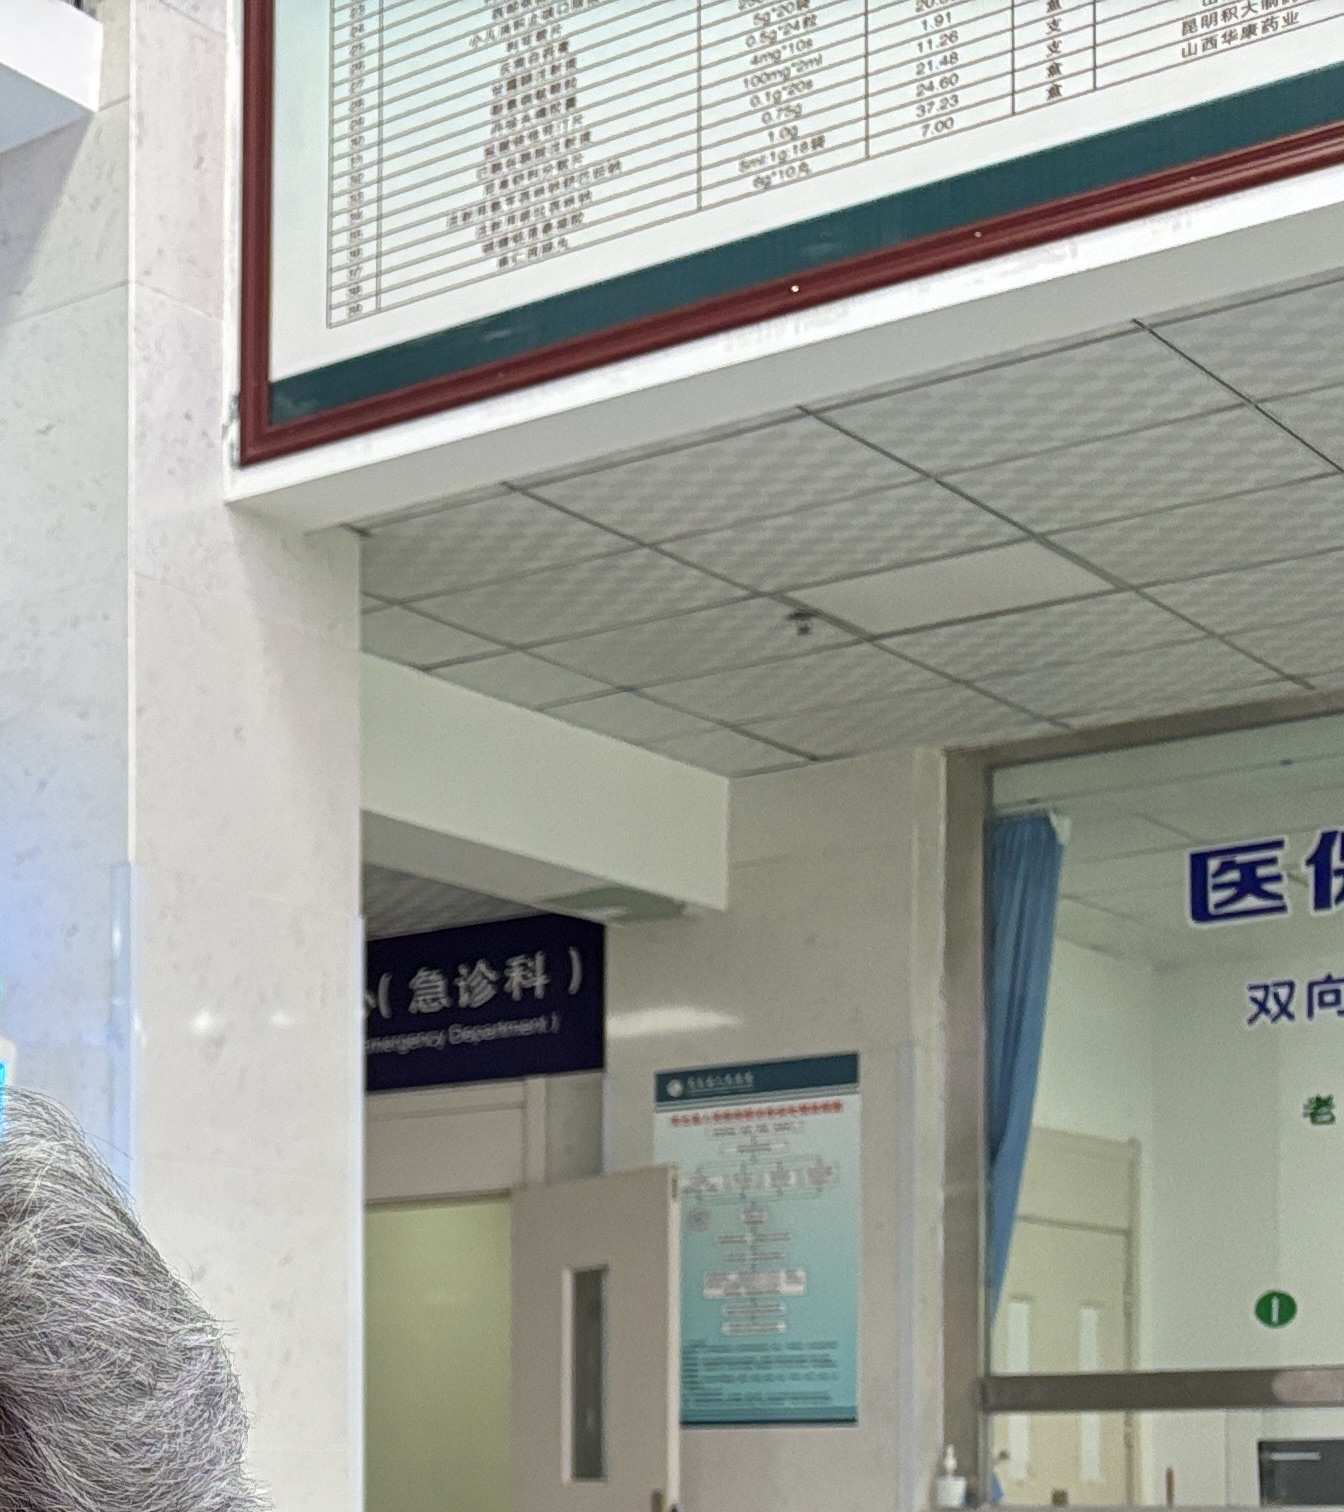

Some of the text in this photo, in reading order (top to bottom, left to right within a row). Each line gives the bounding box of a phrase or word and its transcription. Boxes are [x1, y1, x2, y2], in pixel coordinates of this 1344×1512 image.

[920, 10, 953, 32] 1.91
[1181, 10, 1299, 60] 山西华康药业
[920, 117, 956, 138] 7.00
[365, 946, 583, 1019] (急诊科)
[1248, 975, 1344, 1025] 双向
[365, 1030, 446, 1056] mergency
